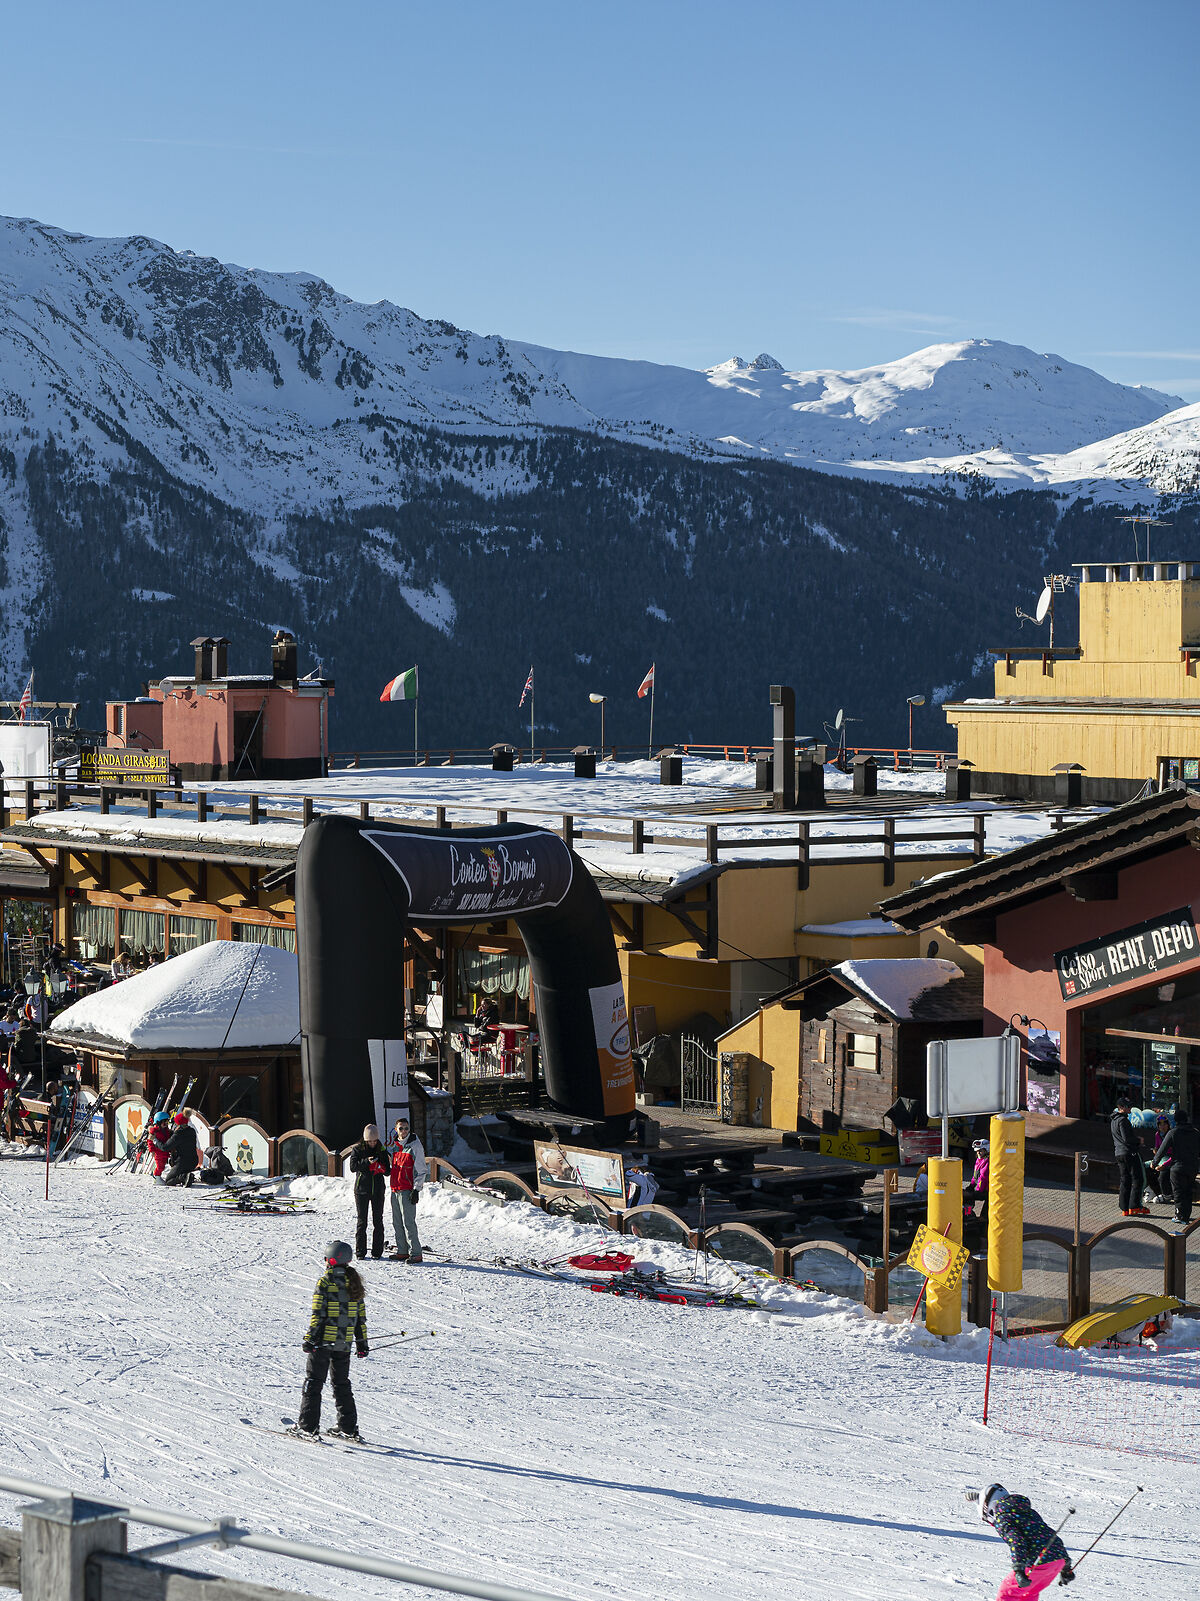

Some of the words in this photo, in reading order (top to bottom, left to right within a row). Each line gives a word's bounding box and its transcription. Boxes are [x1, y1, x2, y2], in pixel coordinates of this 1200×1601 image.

[81, 752, 121, 767] LOCANDA
[123, 754, 167, 769] GIRASOLE
[144, 774, 167, 784] SERVICE
[449, 844, 488, 887] Contea
[497, 843, 537, 886] Bormio
[1150, 919, 1195, 961] DEPO
[1106, 935, 1147, 976] RENT
[1147, 954, 1157, 970] &
[1060, 951, 1096, 979] Celso
[845, 1131, 851, 1142] 1
[826, 1139, 833, 1154] 2
[864, 1147, 871, 1162] 3
[1080, 1154, 1089, 1172] 3
[889, 1172, 898, 1191] 4
